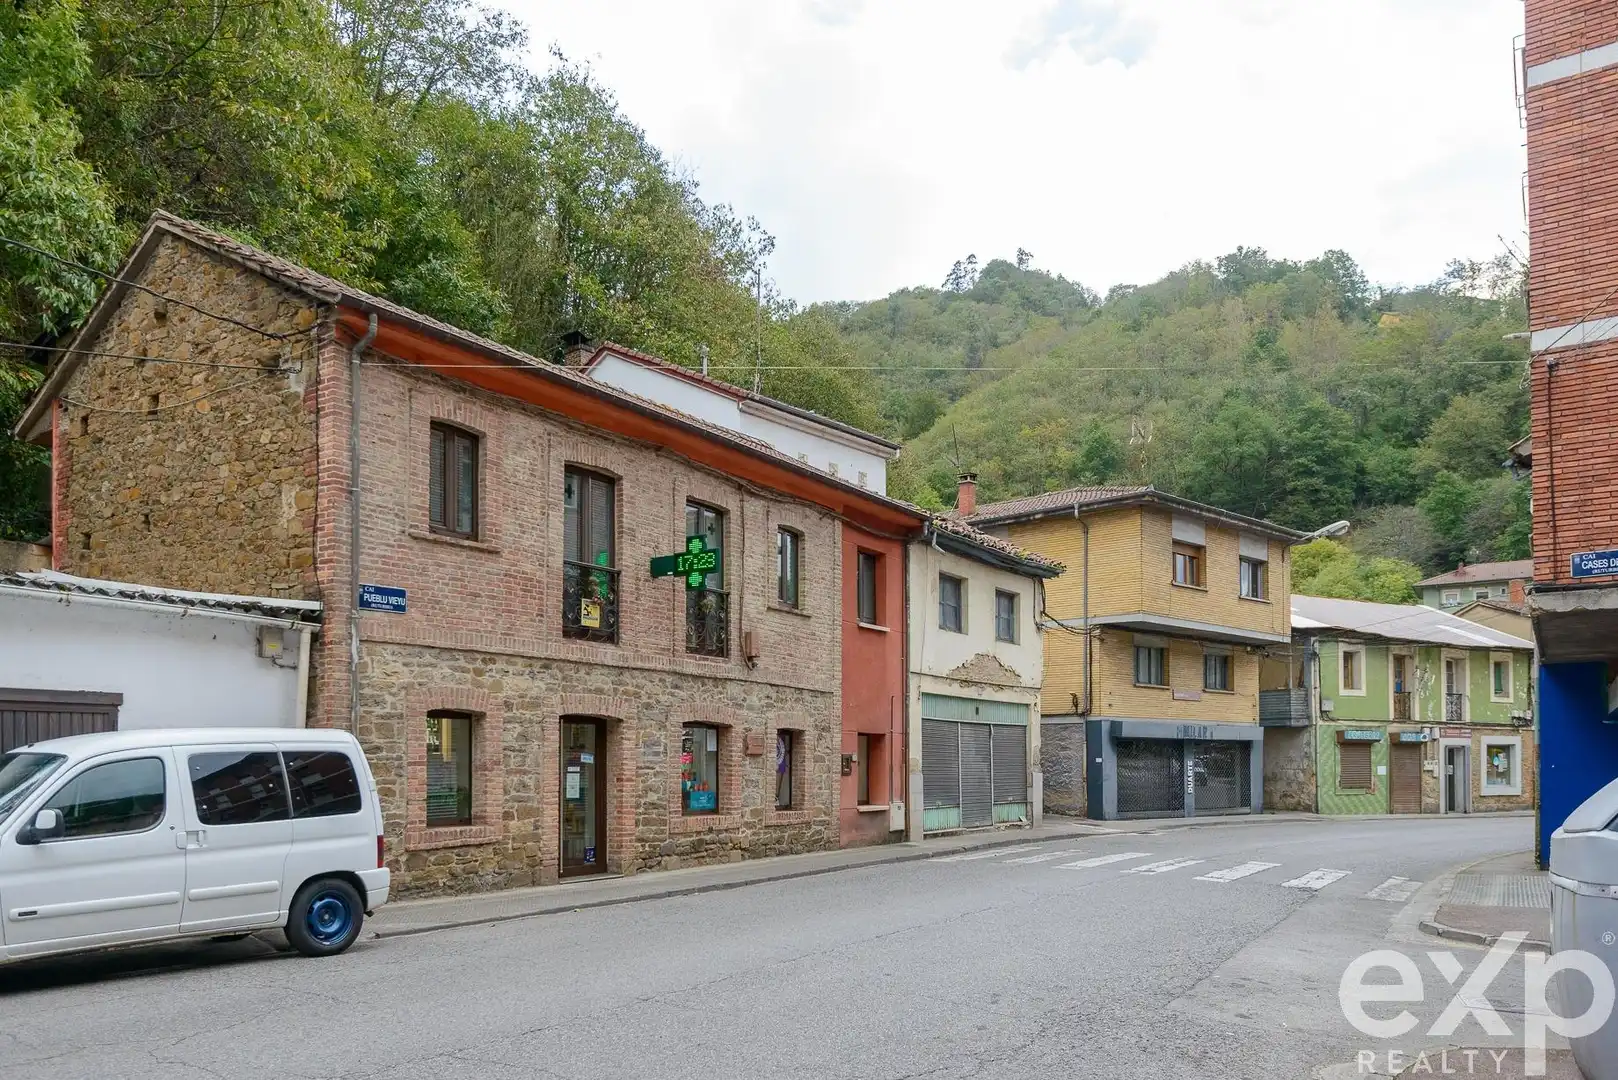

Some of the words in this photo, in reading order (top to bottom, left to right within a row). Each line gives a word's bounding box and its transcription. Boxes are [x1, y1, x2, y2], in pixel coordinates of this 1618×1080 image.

[678, 552, 716, 571] 17:23
[1581, 558, 1608, 570] CASES
[363, 593, 388, 604] PUEBLU
[389, 596, 406, 606] VIEYU
